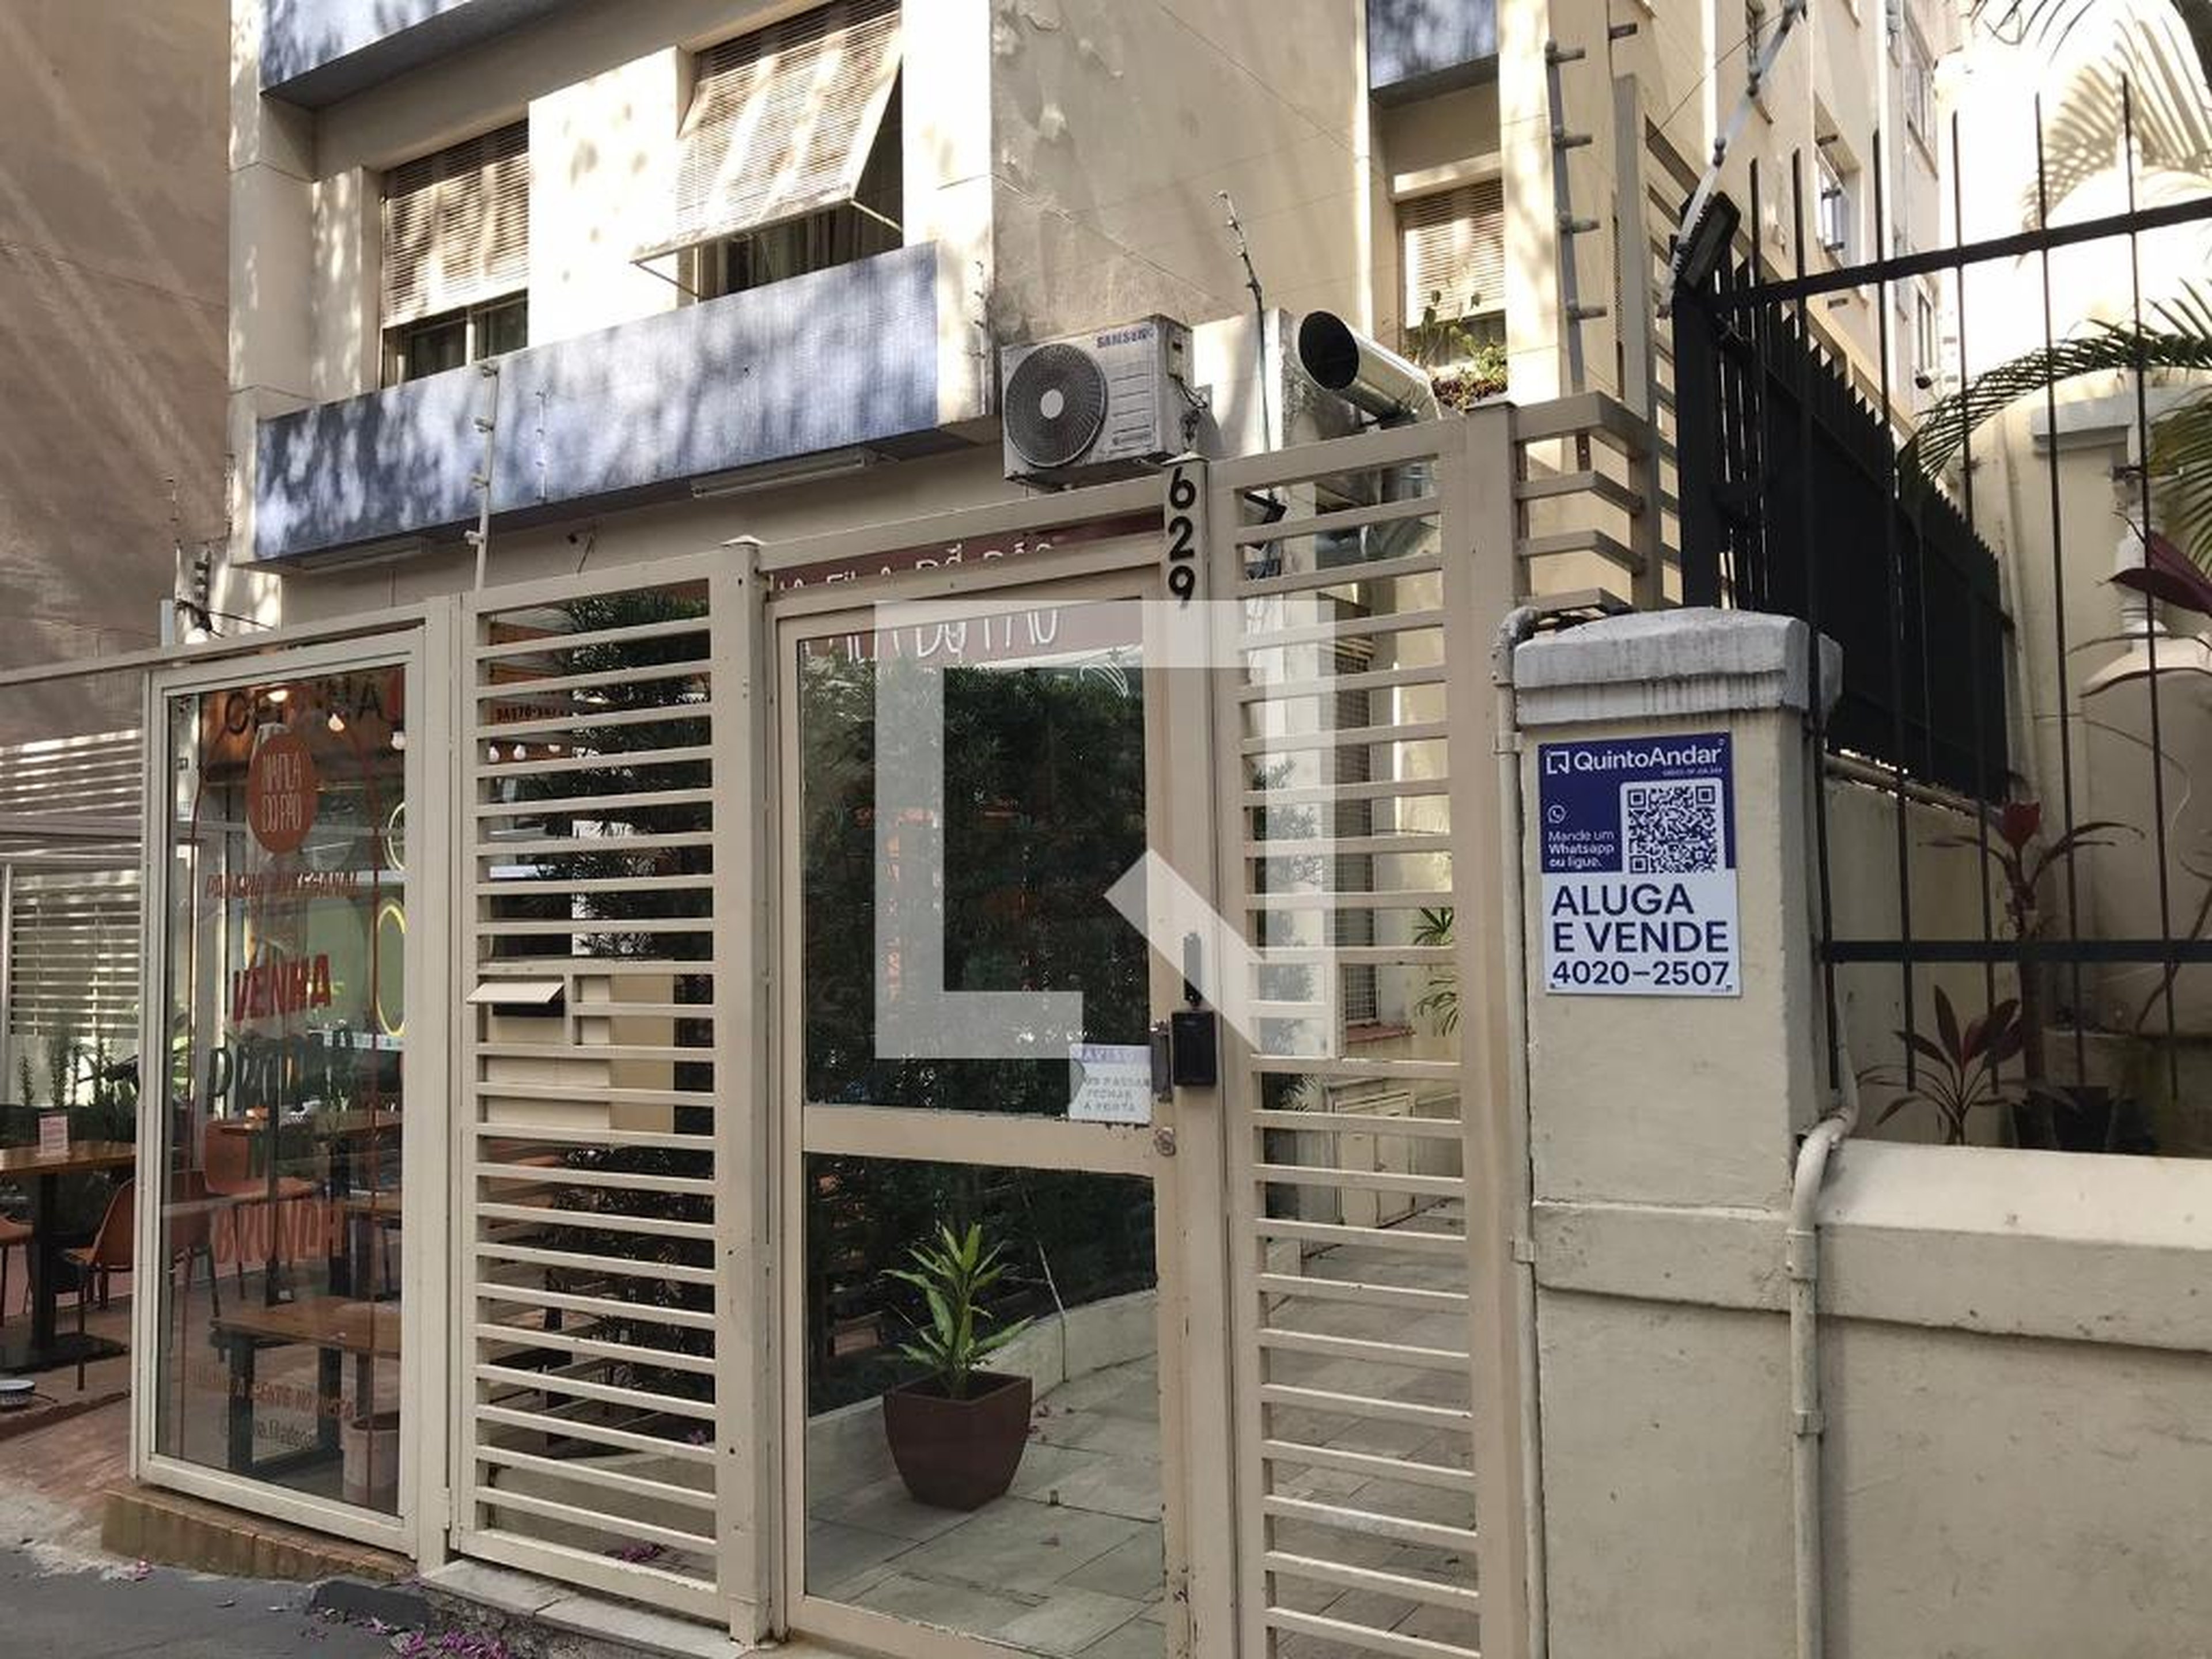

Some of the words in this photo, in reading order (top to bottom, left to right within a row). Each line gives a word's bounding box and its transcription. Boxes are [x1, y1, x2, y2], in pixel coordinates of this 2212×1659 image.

[1097, 327, 1154, 348] SAMSUNG
[1167, 465, 1196, 611] 629
[1574, 745, 1722, 772] QuintoAndar
[1548, 830, 1591, 842] Mande
[1594, 831, 1615, 840] um
[1548, 843, 1615, 857] Whatsapp
[1549, 858, 1565, 868] ou
[1551, 883, 1695, 916] ALUGA
[1554, 922, 1574, 953] E
[1585, 921, 1729, 953] VENDE
